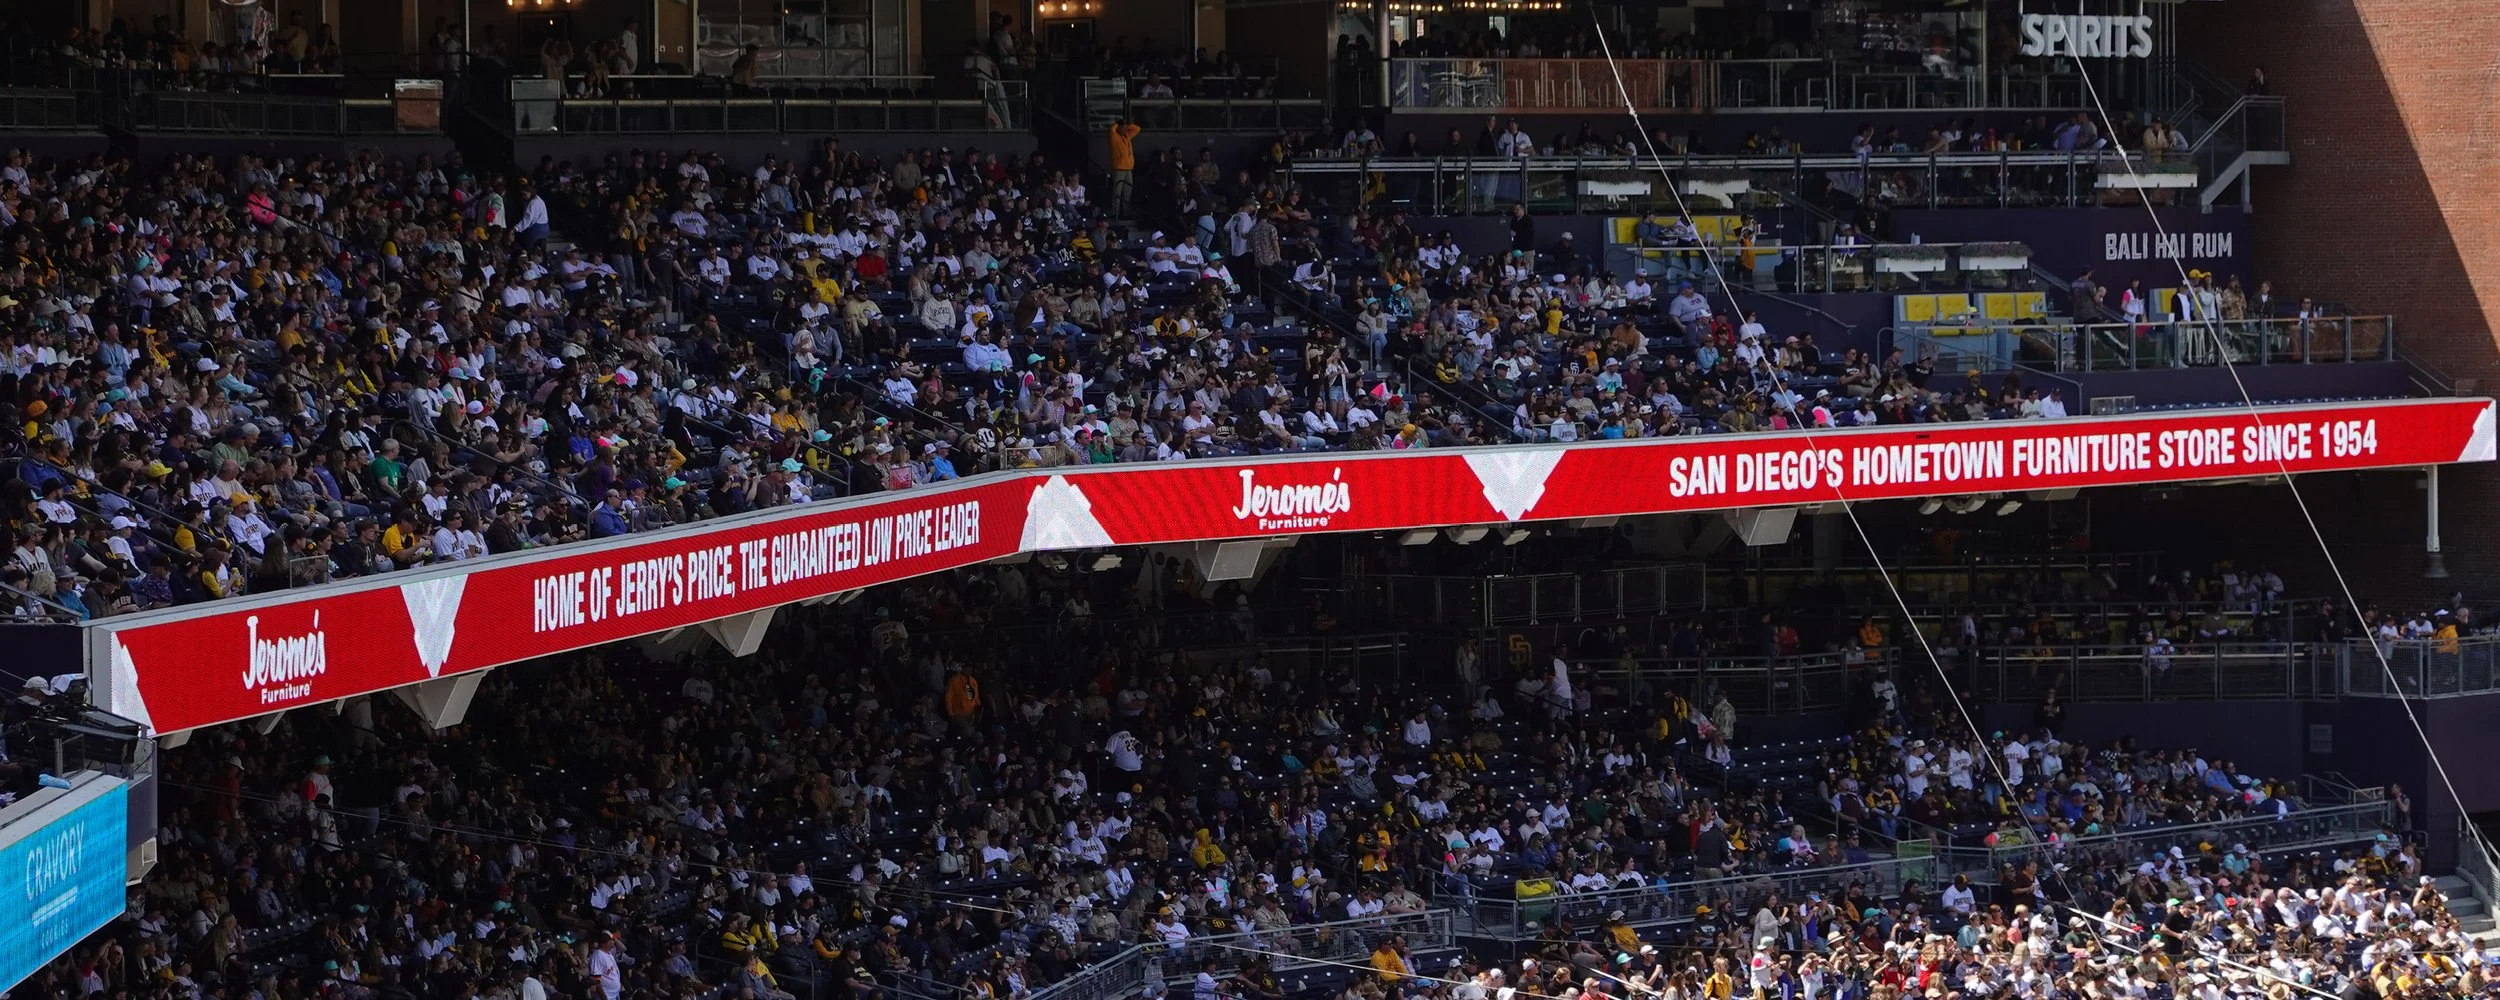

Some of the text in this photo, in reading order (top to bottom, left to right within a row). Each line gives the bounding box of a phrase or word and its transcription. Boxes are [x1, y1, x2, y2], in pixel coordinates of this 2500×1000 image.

[2020, 13, 2153, 58] SPIRITS
[2105, 232, 2233, 261] BALI HAI RUM
[1669, 419, 2377, 497] SAN DIEGO'S HOMETOWN FURNITURE STORE SINCE 1954
[1232, 467, 1350, 519] Jerome's
[1259, 515, 1329, 531] Furniture
[534, 500, 980, 633] HOME OF JERRY'S PRICE, THE GUARANTEED LOW PRICE LEADER
[243, 609, 326, 690] Jerome's
[261, 683, 312, 705] Furniture
[26, 820, 84, 901] CRAVORY
